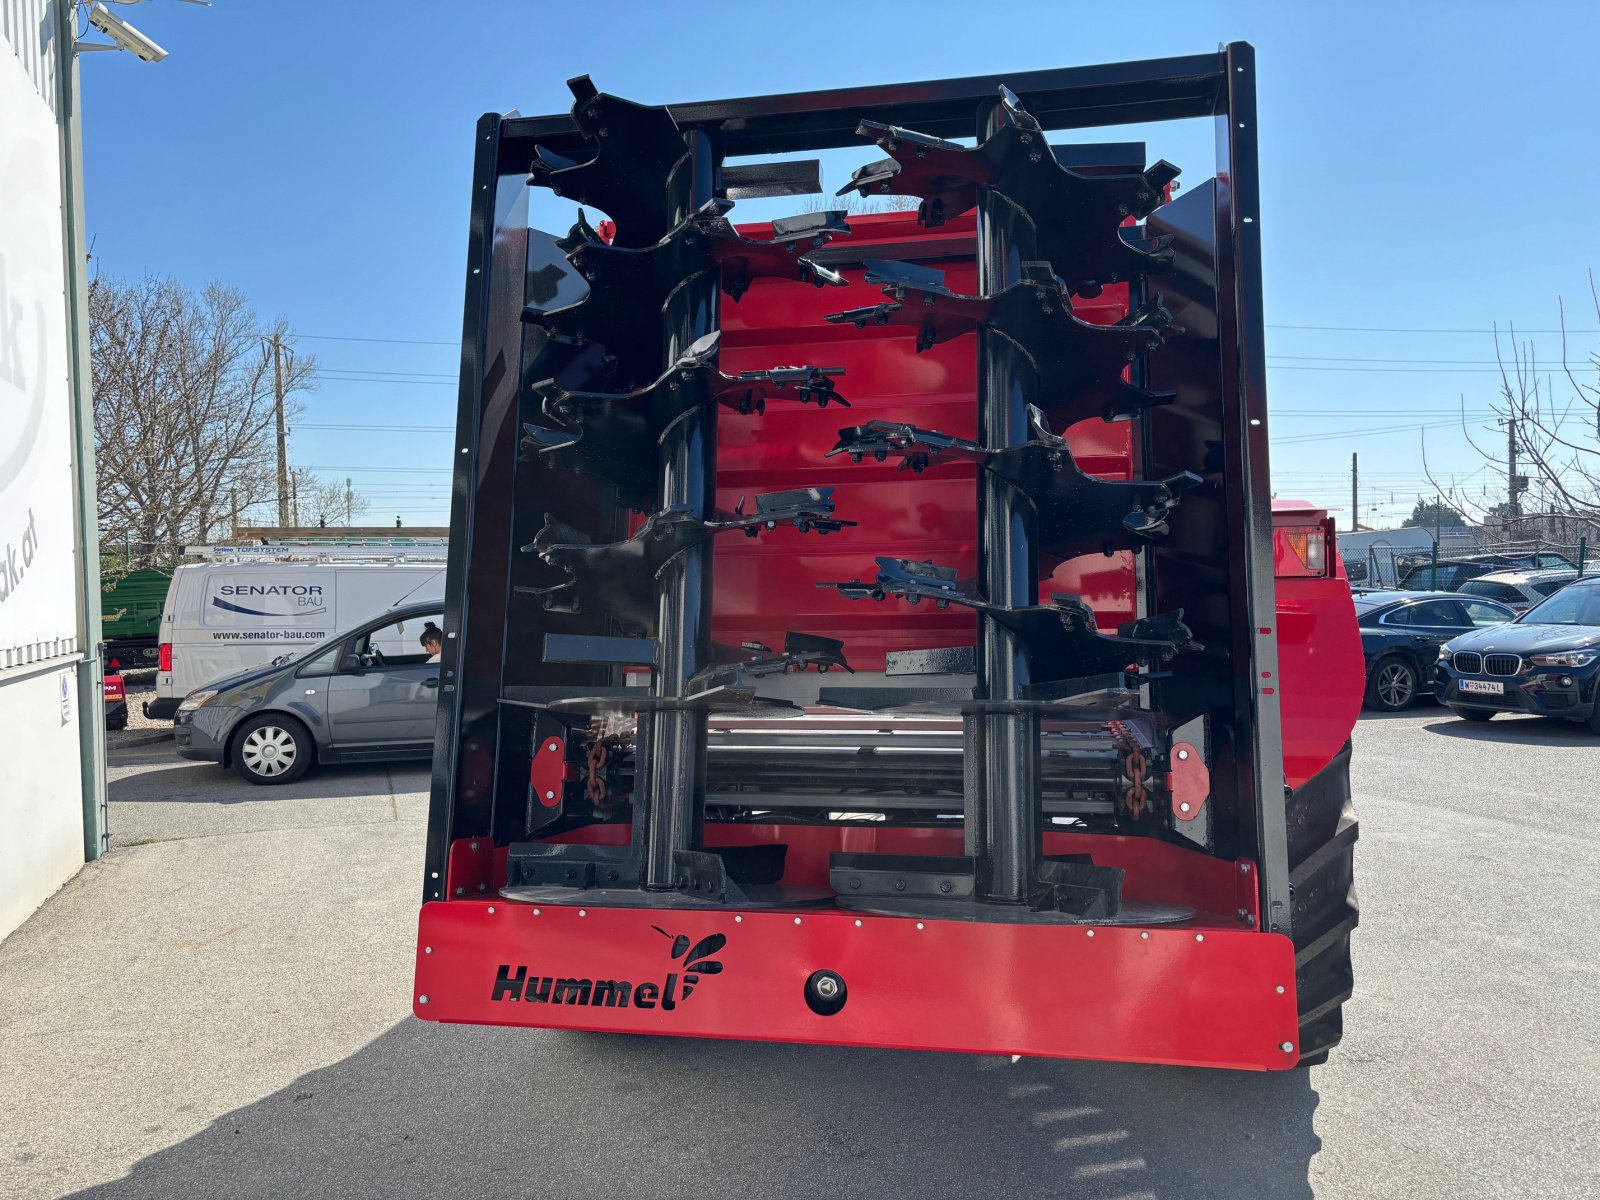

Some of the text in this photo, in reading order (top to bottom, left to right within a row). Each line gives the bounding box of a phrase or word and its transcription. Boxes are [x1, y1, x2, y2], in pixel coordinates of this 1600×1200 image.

[220, 585, 323, 596] SENATOR
[297, 596, 323, 607] BAU
[213, 630, 326, 640] www.senator-bau.com
[491, 964, 678, 1011] Hummel
